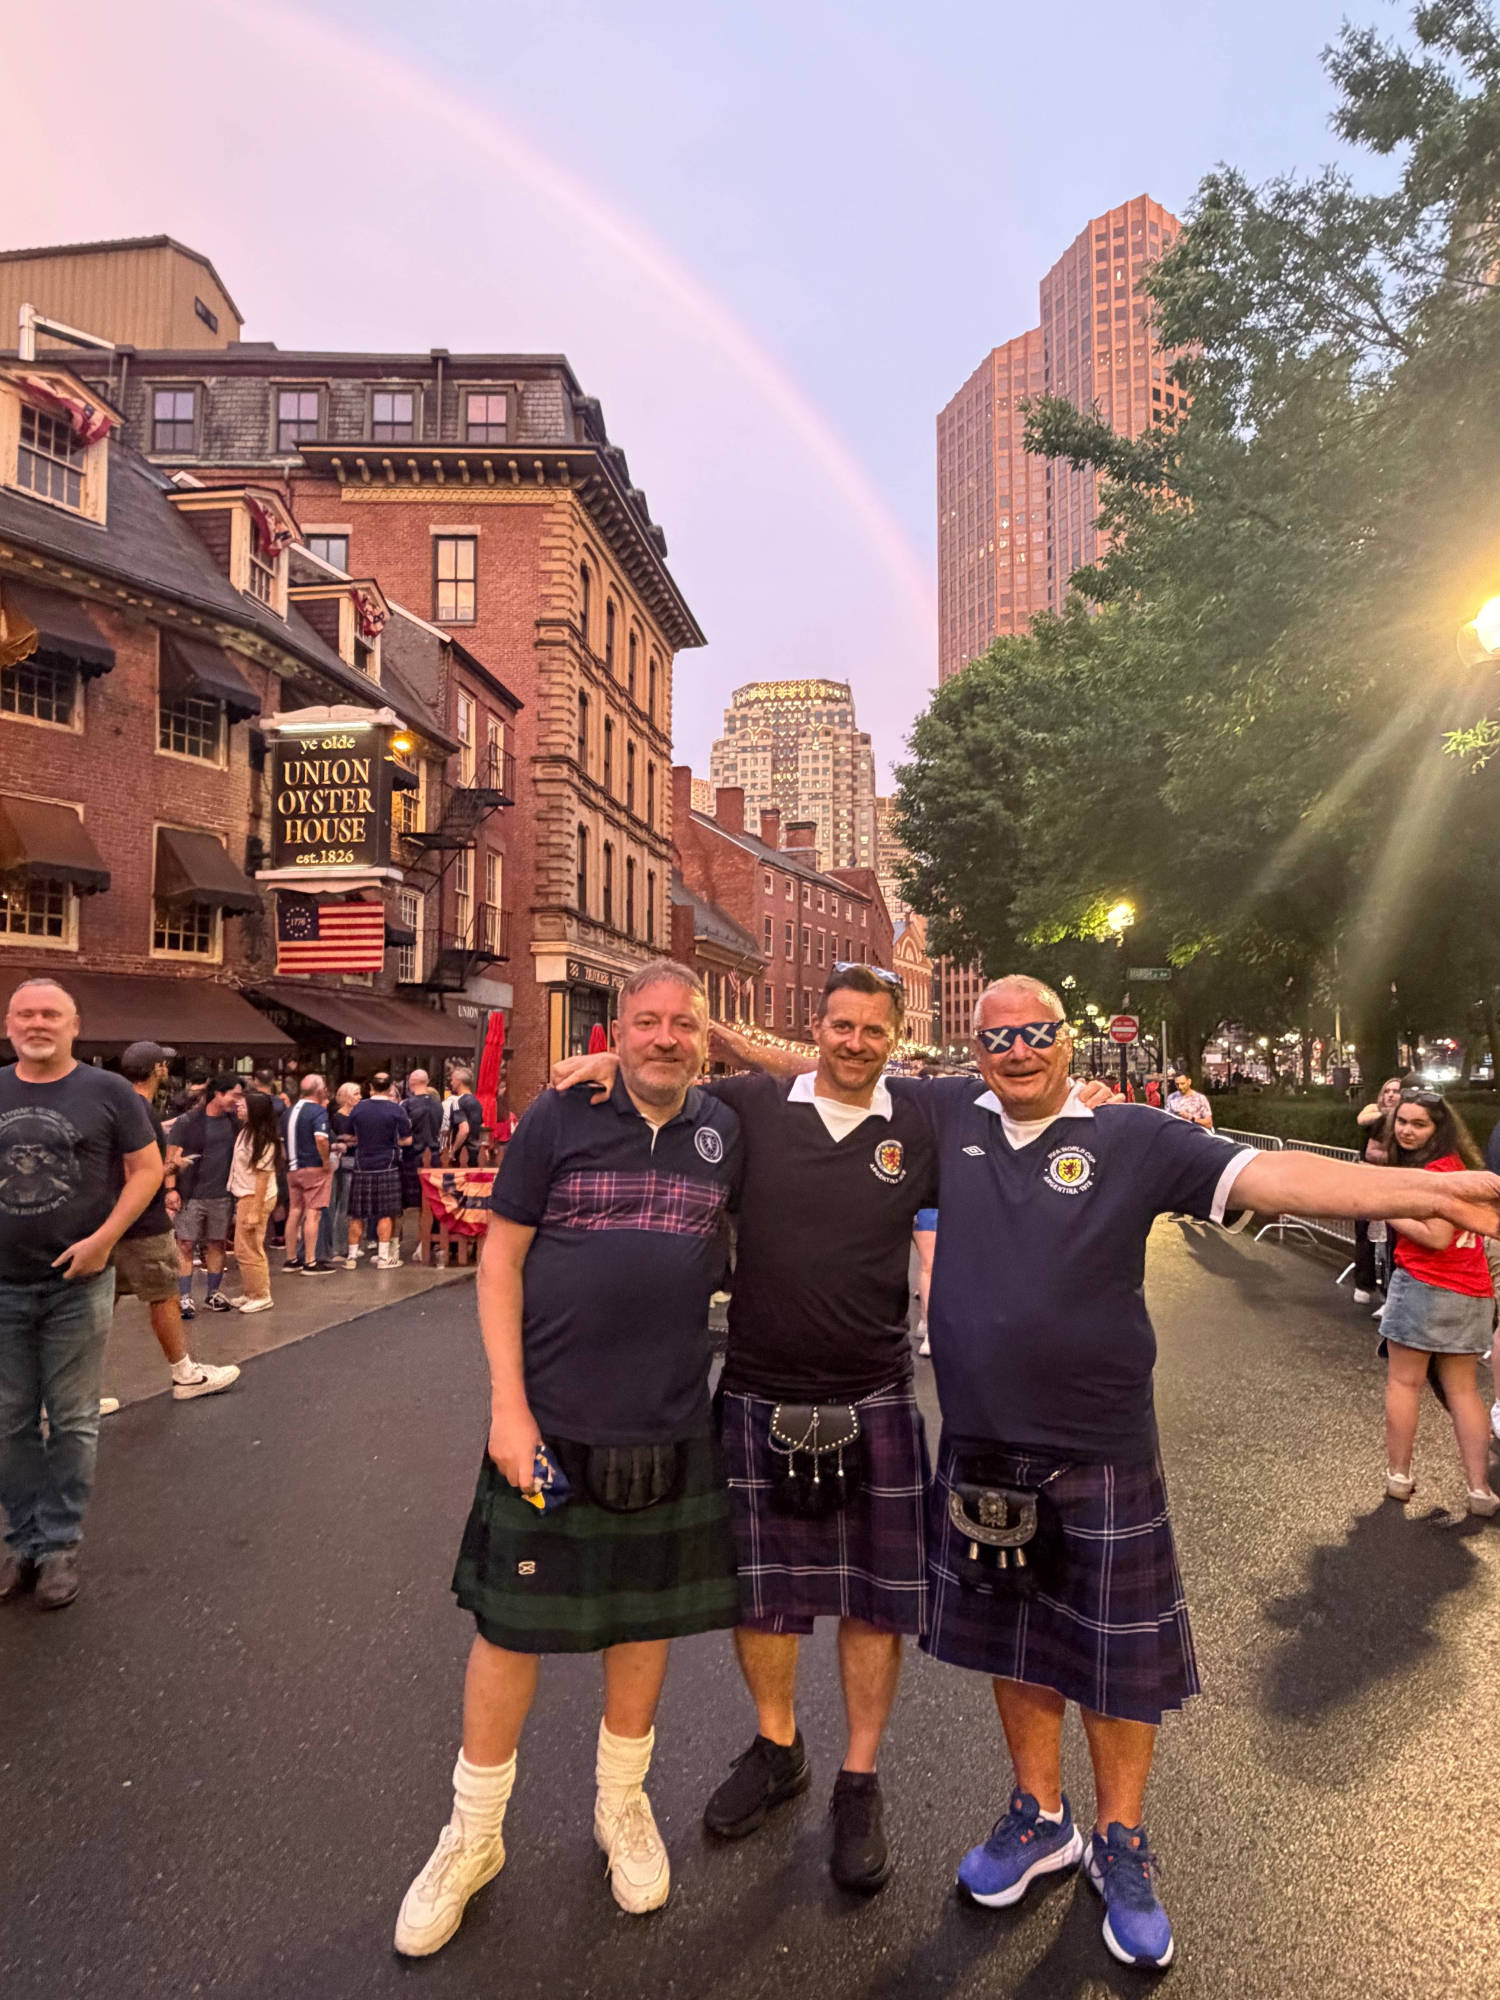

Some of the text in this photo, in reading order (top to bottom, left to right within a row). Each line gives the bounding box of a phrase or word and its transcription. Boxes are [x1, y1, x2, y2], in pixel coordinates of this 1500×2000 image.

[300, 734, 356, 755] ye olde
[283, 758, 371, 786] UNION
[277, 787, 375, 815] OYSTER
[283, 817, 366, 844] HOUSE
[291, 917, 307, 927] 1776
[458, 1004, 479, 1019] UNION
[1060, 1145, 1085, 1154] WORLD
[1084, 1151, 1096, 1164] CUP
[1043, 1176, 1079, 1194] ARGENTINA
